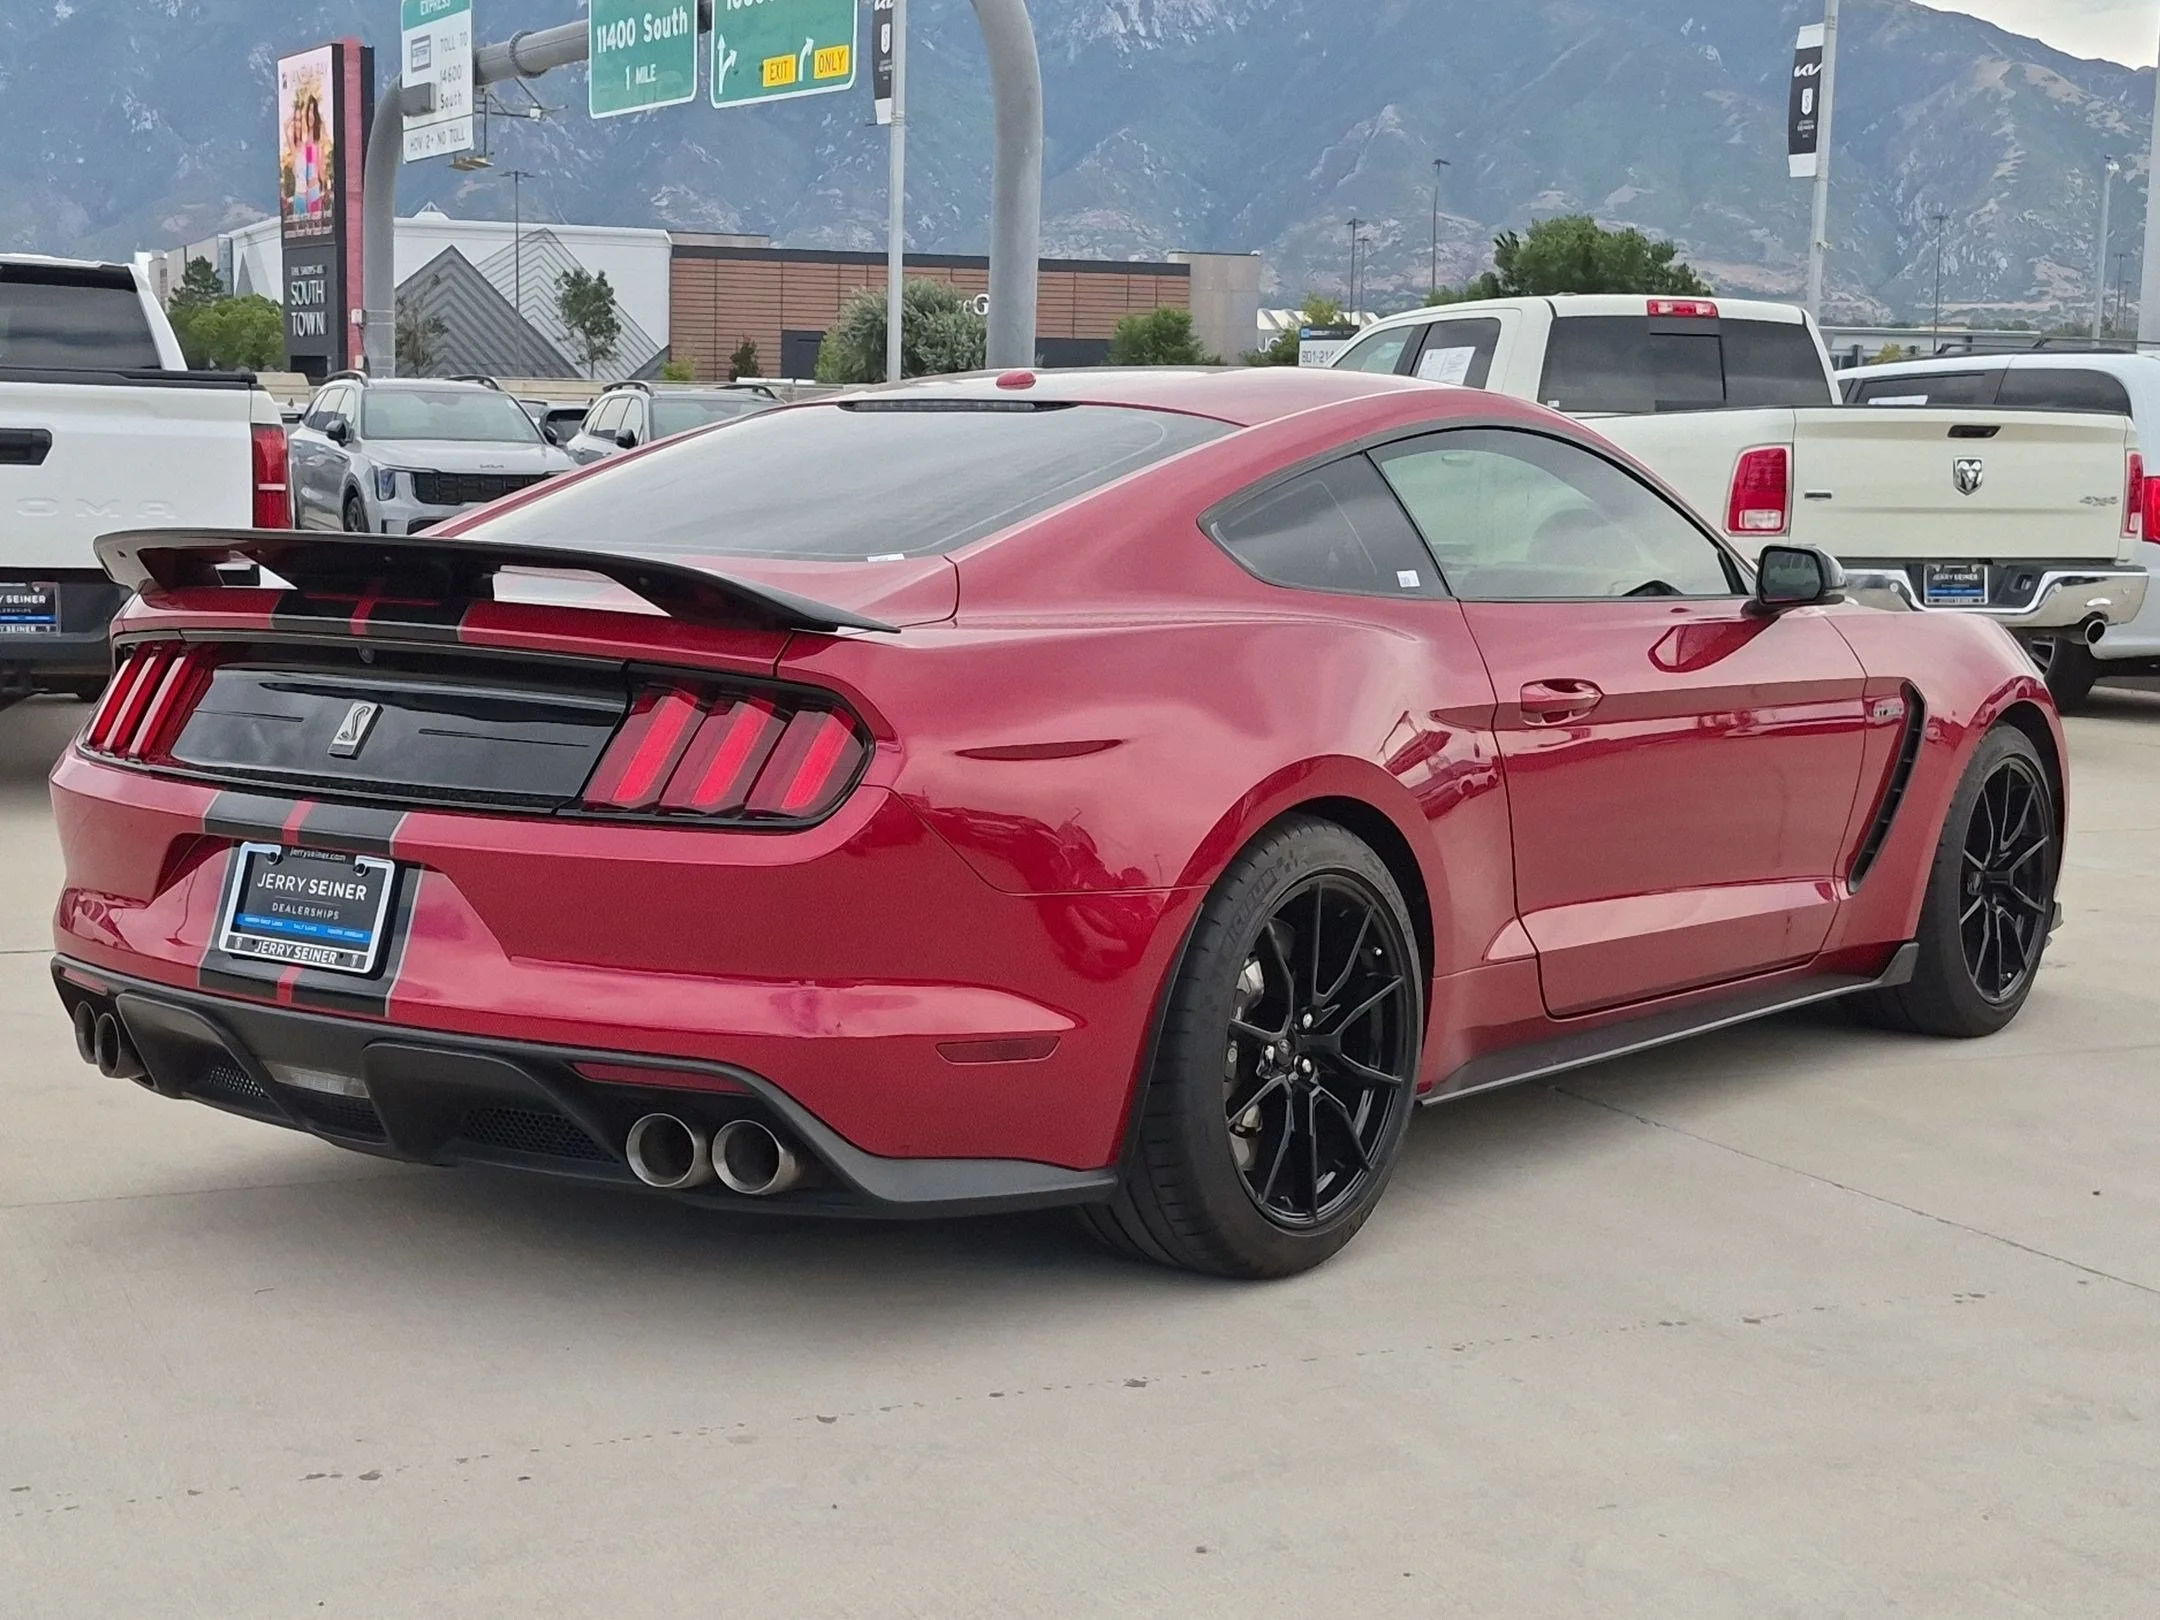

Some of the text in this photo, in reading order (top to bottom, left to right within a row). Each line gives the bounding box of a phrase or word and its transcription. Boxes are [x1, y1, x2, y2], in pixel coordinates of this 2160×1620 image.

[597, 5, 688, 54] 11400 South
[440, 35, 456, 52] TOLL
[769, 60, 789, 81] EXIT
[818, 49, 845, 74] ONLY
[625, 63, 657, 91] 1 MILE
[440, 90, 463, 110] South
[290, 280, 325, 306] SOUTH
[290, 311, 326, 337] TOWN
[6, 594, 47, 605] SEINER
[290, 847, 347, 862] jerryseiner.com
[257, 872, 368, 901] JERRY SEINER
[272, 903, 340, 920] DEALERSHIPS
[254, 940, 292, 957] JERRY
[293, 946, 338, 964] SEINER
